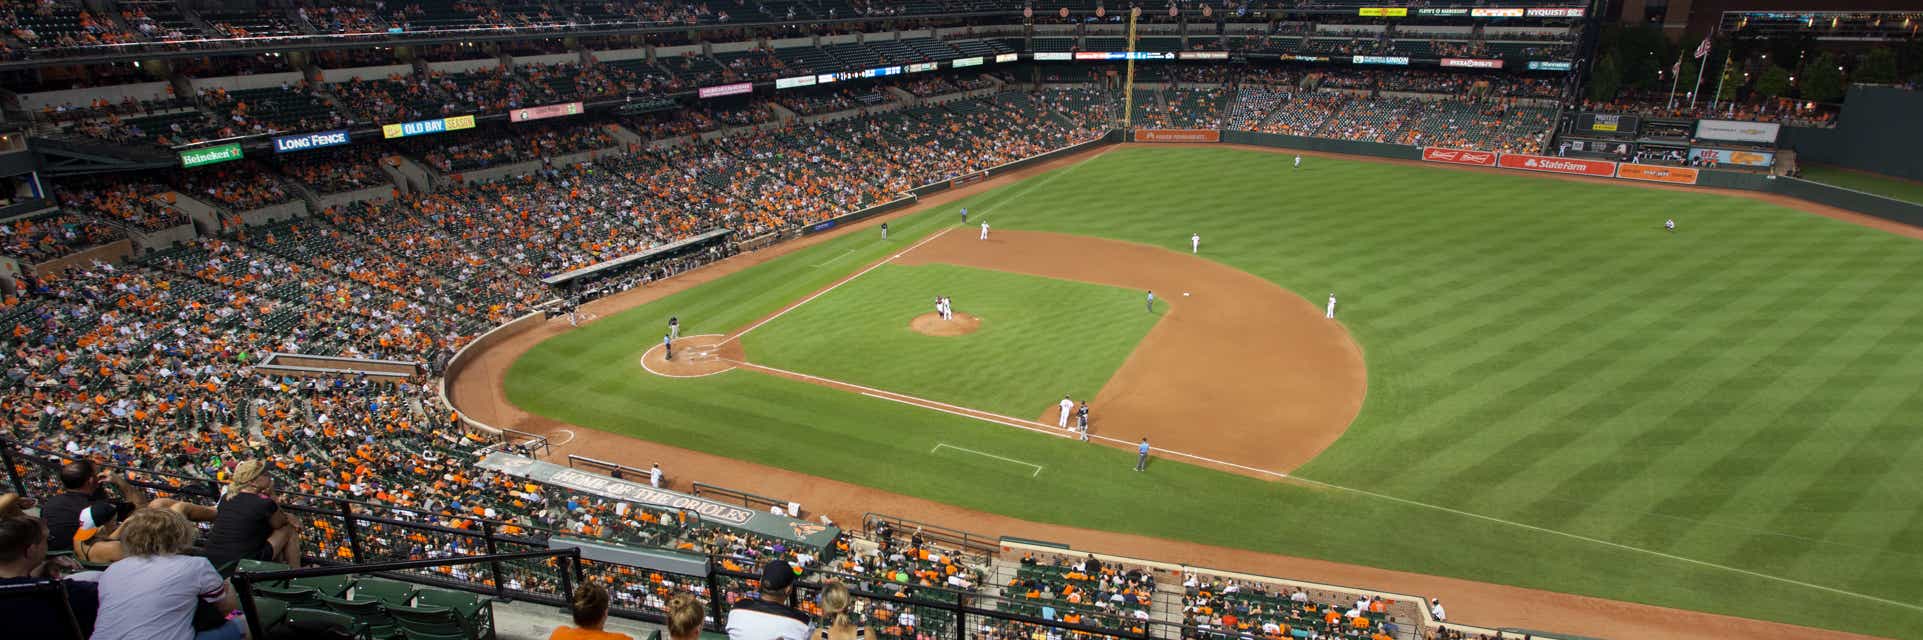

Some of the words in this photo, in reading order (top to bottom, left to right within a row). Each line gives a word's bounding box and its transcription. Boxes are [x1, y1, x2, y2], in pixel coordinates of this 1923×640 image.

[404, 122, 424, 135] OLD
[425, 119, 444, 132] BAY
[447, 118, 474, 131] SEASON
[278, 137, 310, 151] LONG
[310, 133, 346, 148] FENCE
[182, 148, 230, 165] Heineken
[551, 469, 609, 490] HOME
[608, 483, 637, 497] OF
[635, 488, 673, 505] THE
[672, 497, 751, 522] ORIOLES
